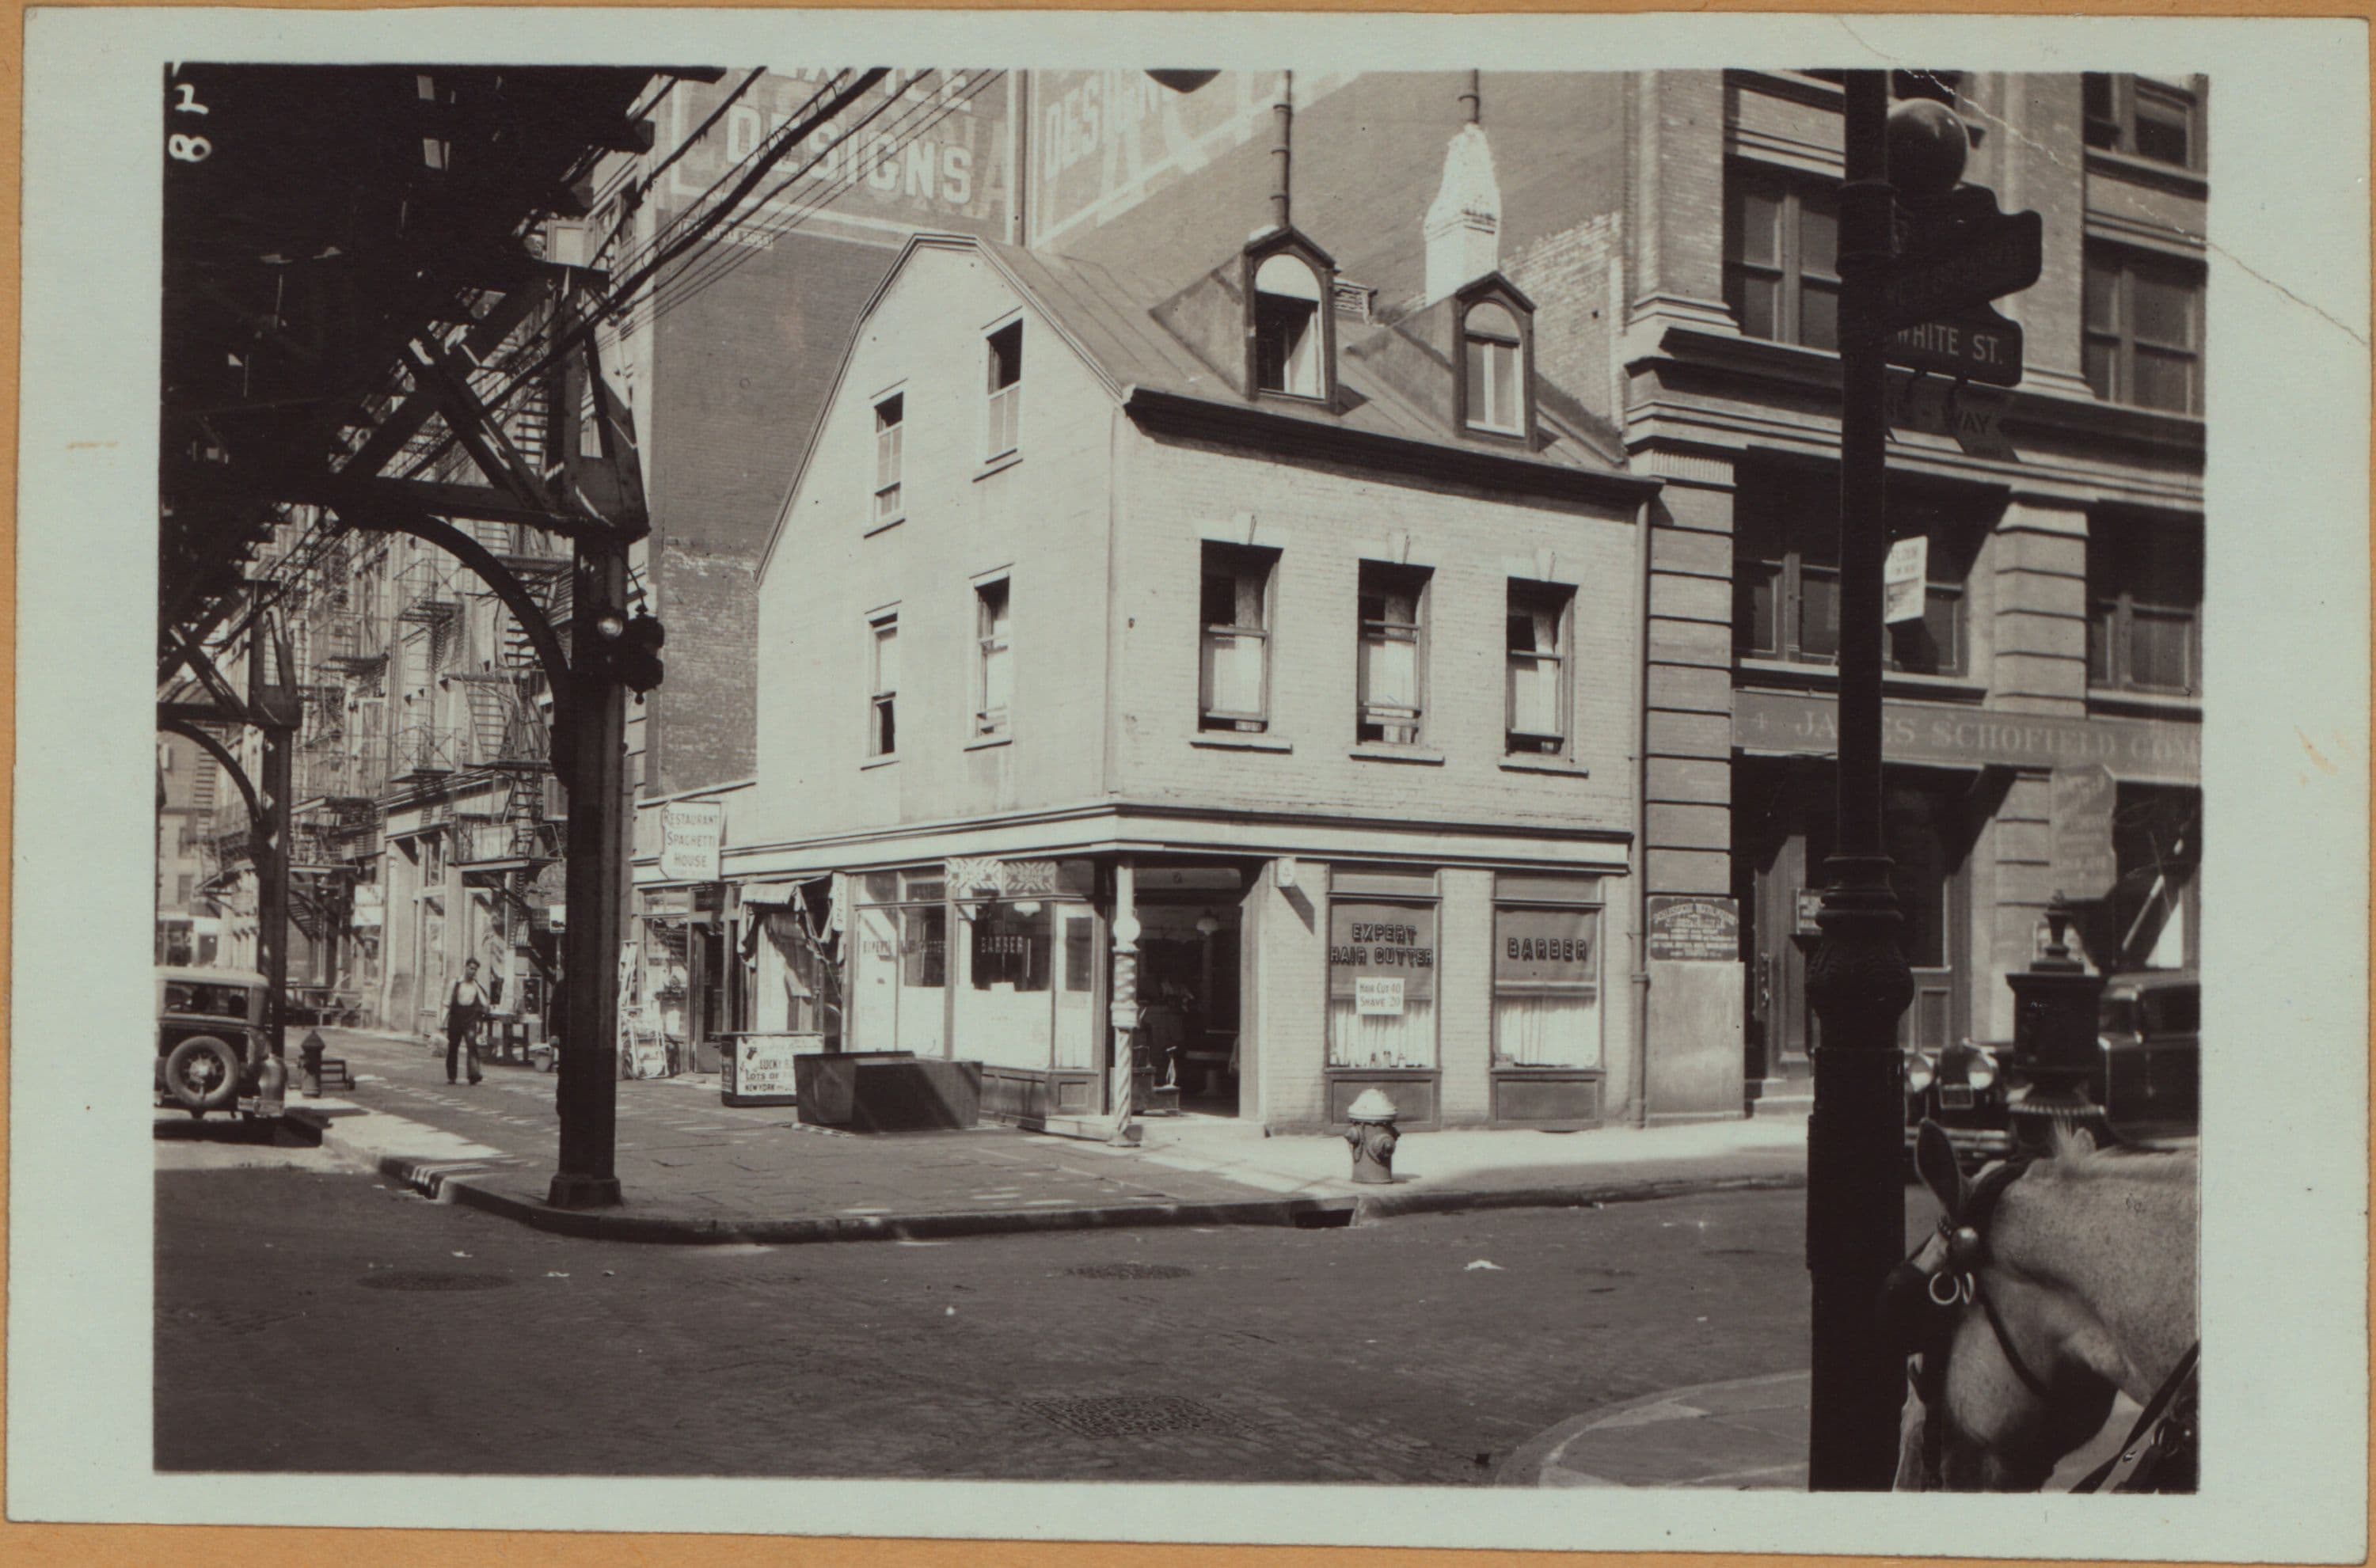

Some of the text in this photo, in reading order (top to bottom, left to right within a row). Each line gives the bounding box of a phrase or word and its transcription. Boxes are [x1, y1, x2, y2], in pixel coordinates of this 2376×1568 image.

[727, 104, 971, 204] DESIGNS
[1972, 333, 2003, 365] ST.
[1932, 719, 2116, 757] SCHOFIELD
[663, 809, 718, 826] RESTAURANT
[667, 830, 716, 847] SPAGHETTI
[674, 852, 708, 868] HOUSE
[981, 936, 1024, 955] BARBER
[1351, 923, 1417, 946] EXPERT
[1331, 946, 1433, 968] HAIR CUTTER
[1507, 937, 1587, 962] BARBER
